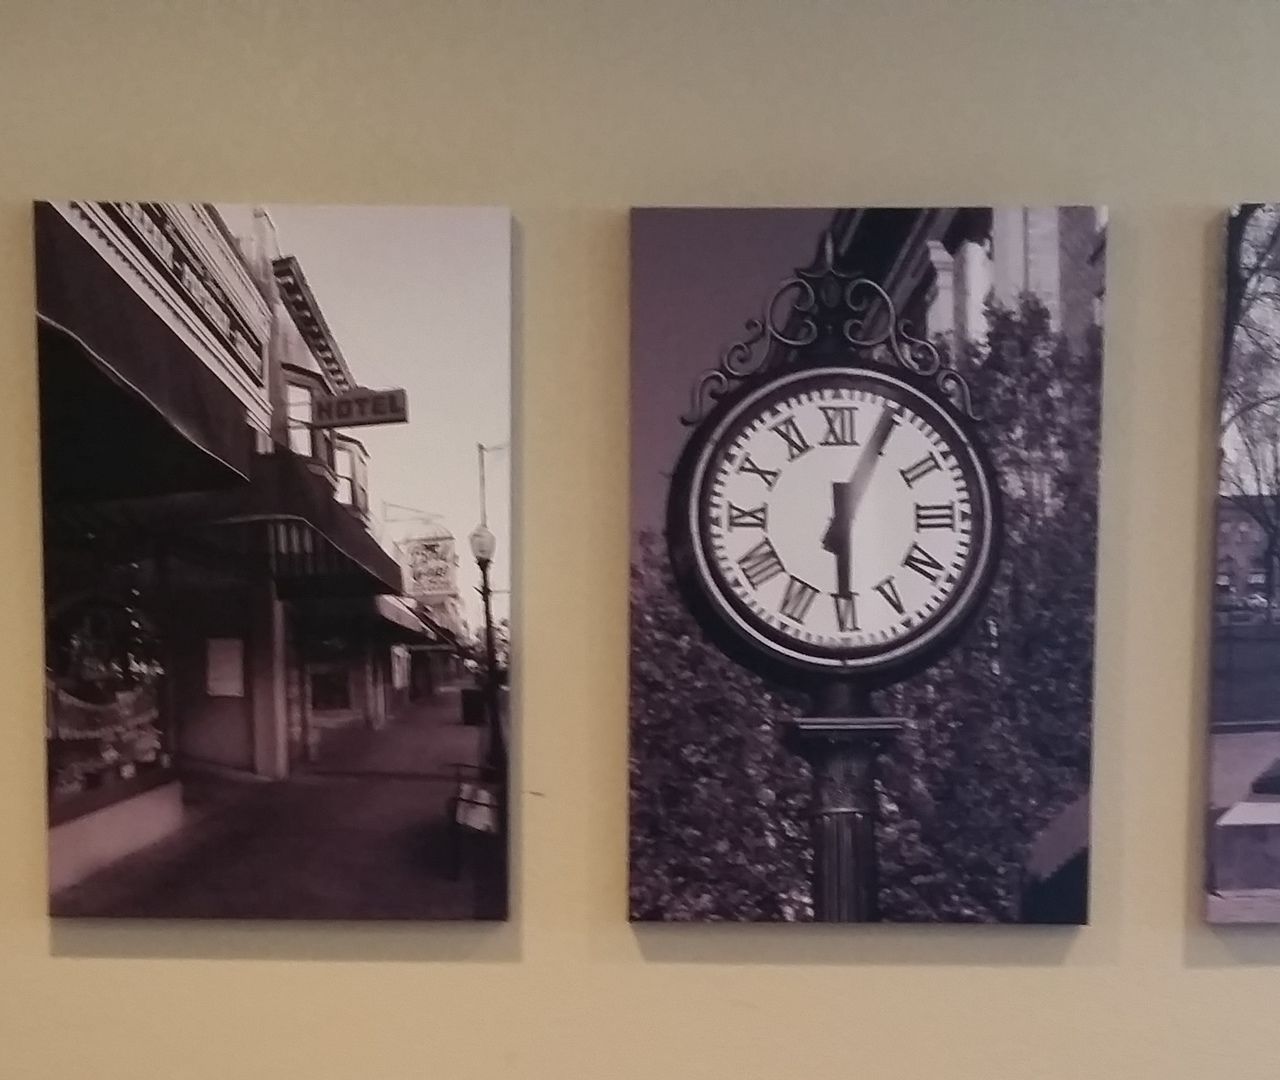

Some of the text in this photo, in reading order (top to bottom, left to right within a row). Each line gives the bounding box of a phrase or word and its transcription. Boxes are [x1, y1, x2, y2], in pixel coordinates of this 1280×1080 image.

[317, 393, 401, 420] HOTEL
[770, 415, 815, 462] XI
[819, 406, 860, 446] XII
[737, 453, 782, 491] X
[899, 451, 944, 488] II
[727, 501, 768, 532] IX
[915, 501, 958, 533] III
[737, 538, 790, 591] VIII
[779, 575, 822, 624] VII
